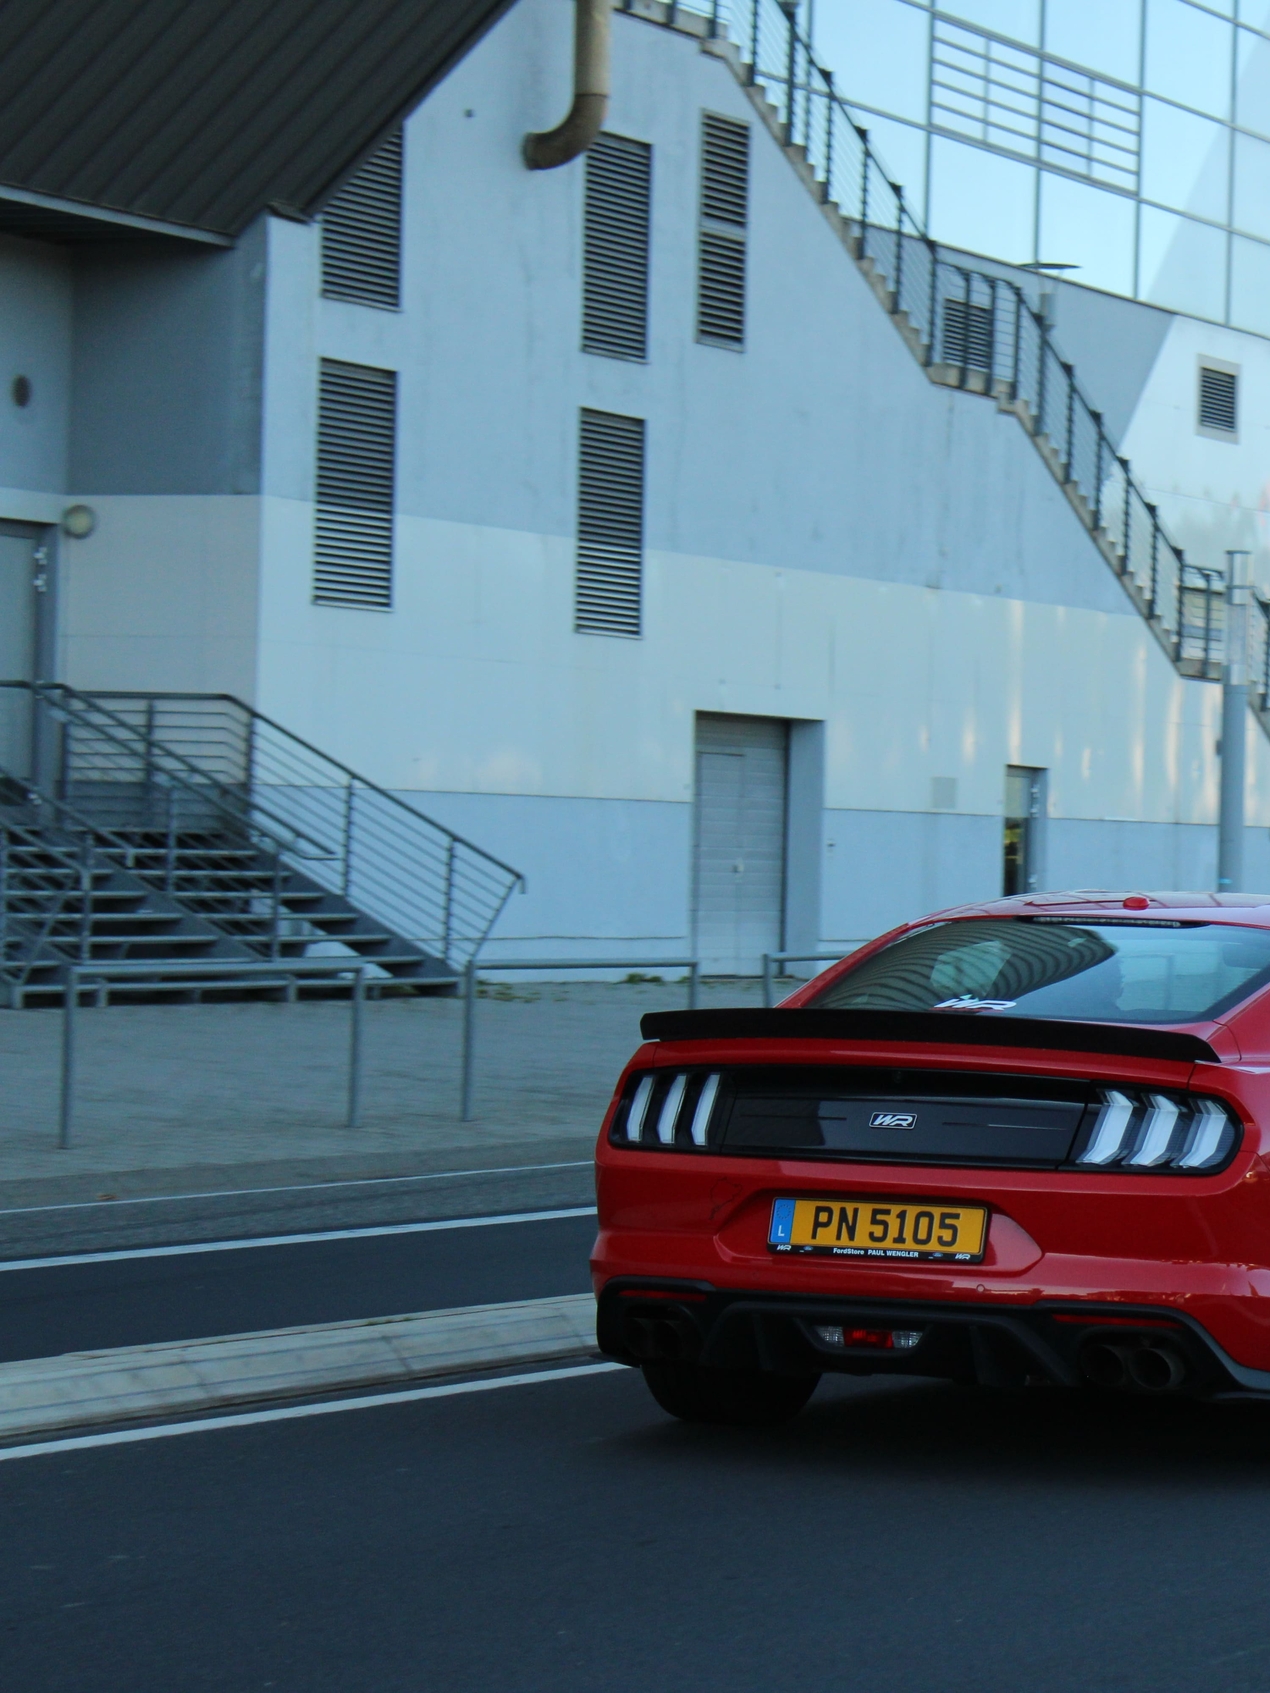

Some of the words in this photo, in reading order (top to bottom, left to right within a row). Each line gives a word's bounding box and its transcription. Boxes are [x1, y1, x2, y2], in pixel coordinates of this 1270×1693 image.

[873, 1114, 913, 1127] WR
[777, 1225, 785, 1236] L
[811, 1205, 860, 1242] PN
[868, 1208, 961, 1247] 5105
[833, 1247, 864, 1255] FordStore
[886, 1250, 919, 1258] WENGLER
